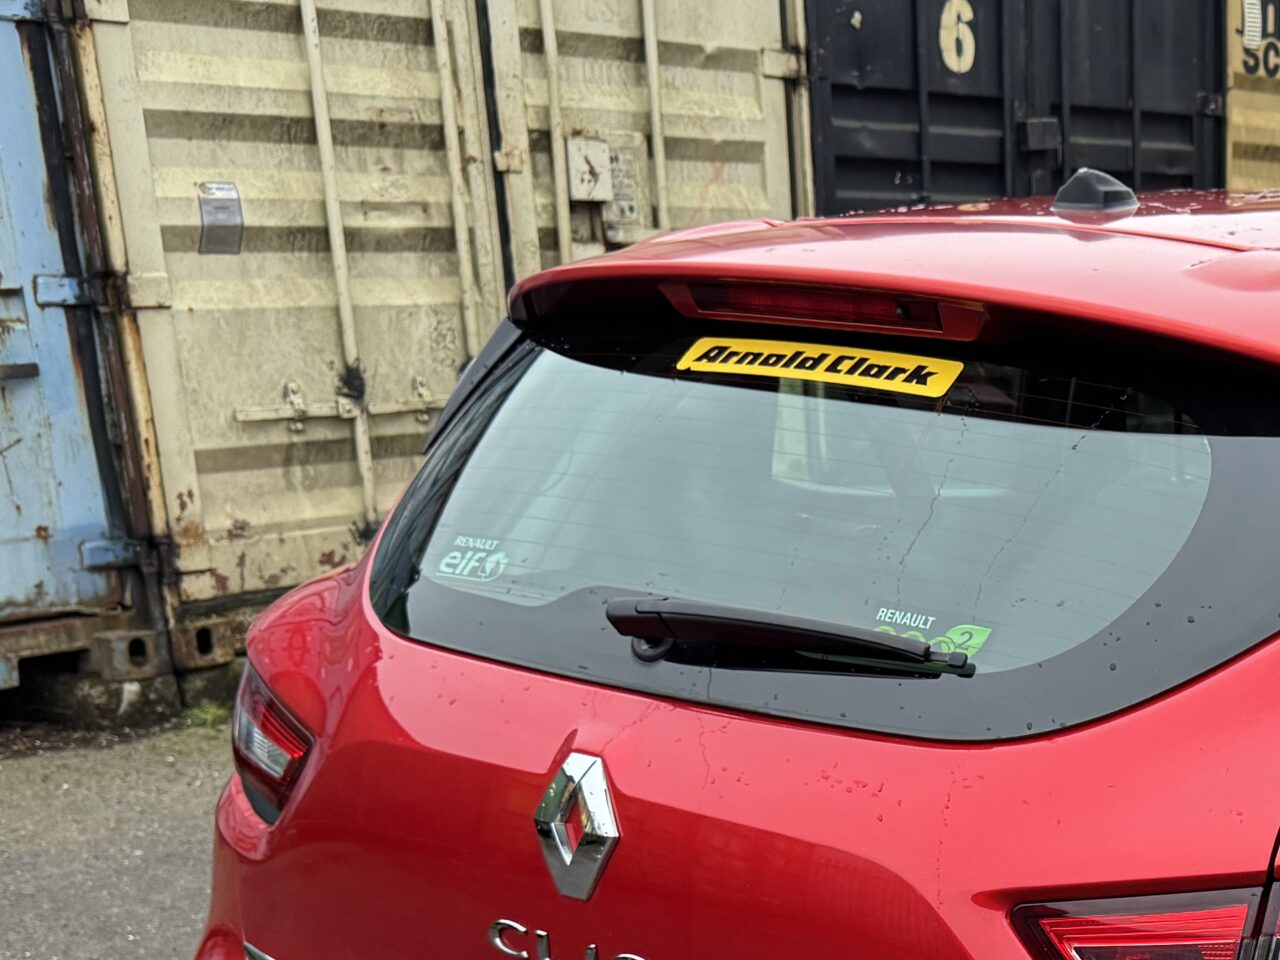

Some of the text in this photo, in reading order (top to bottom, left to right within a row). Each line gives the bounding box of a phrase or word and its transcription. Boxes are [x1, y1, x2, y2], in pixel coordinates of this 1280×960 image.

[938, 0, 976, 74] 6
[692, 344, 939, 387] Arnold Clark
[454, 535, 499, 551] RENAULT
[875, 607, 937, 630] RENAULT
